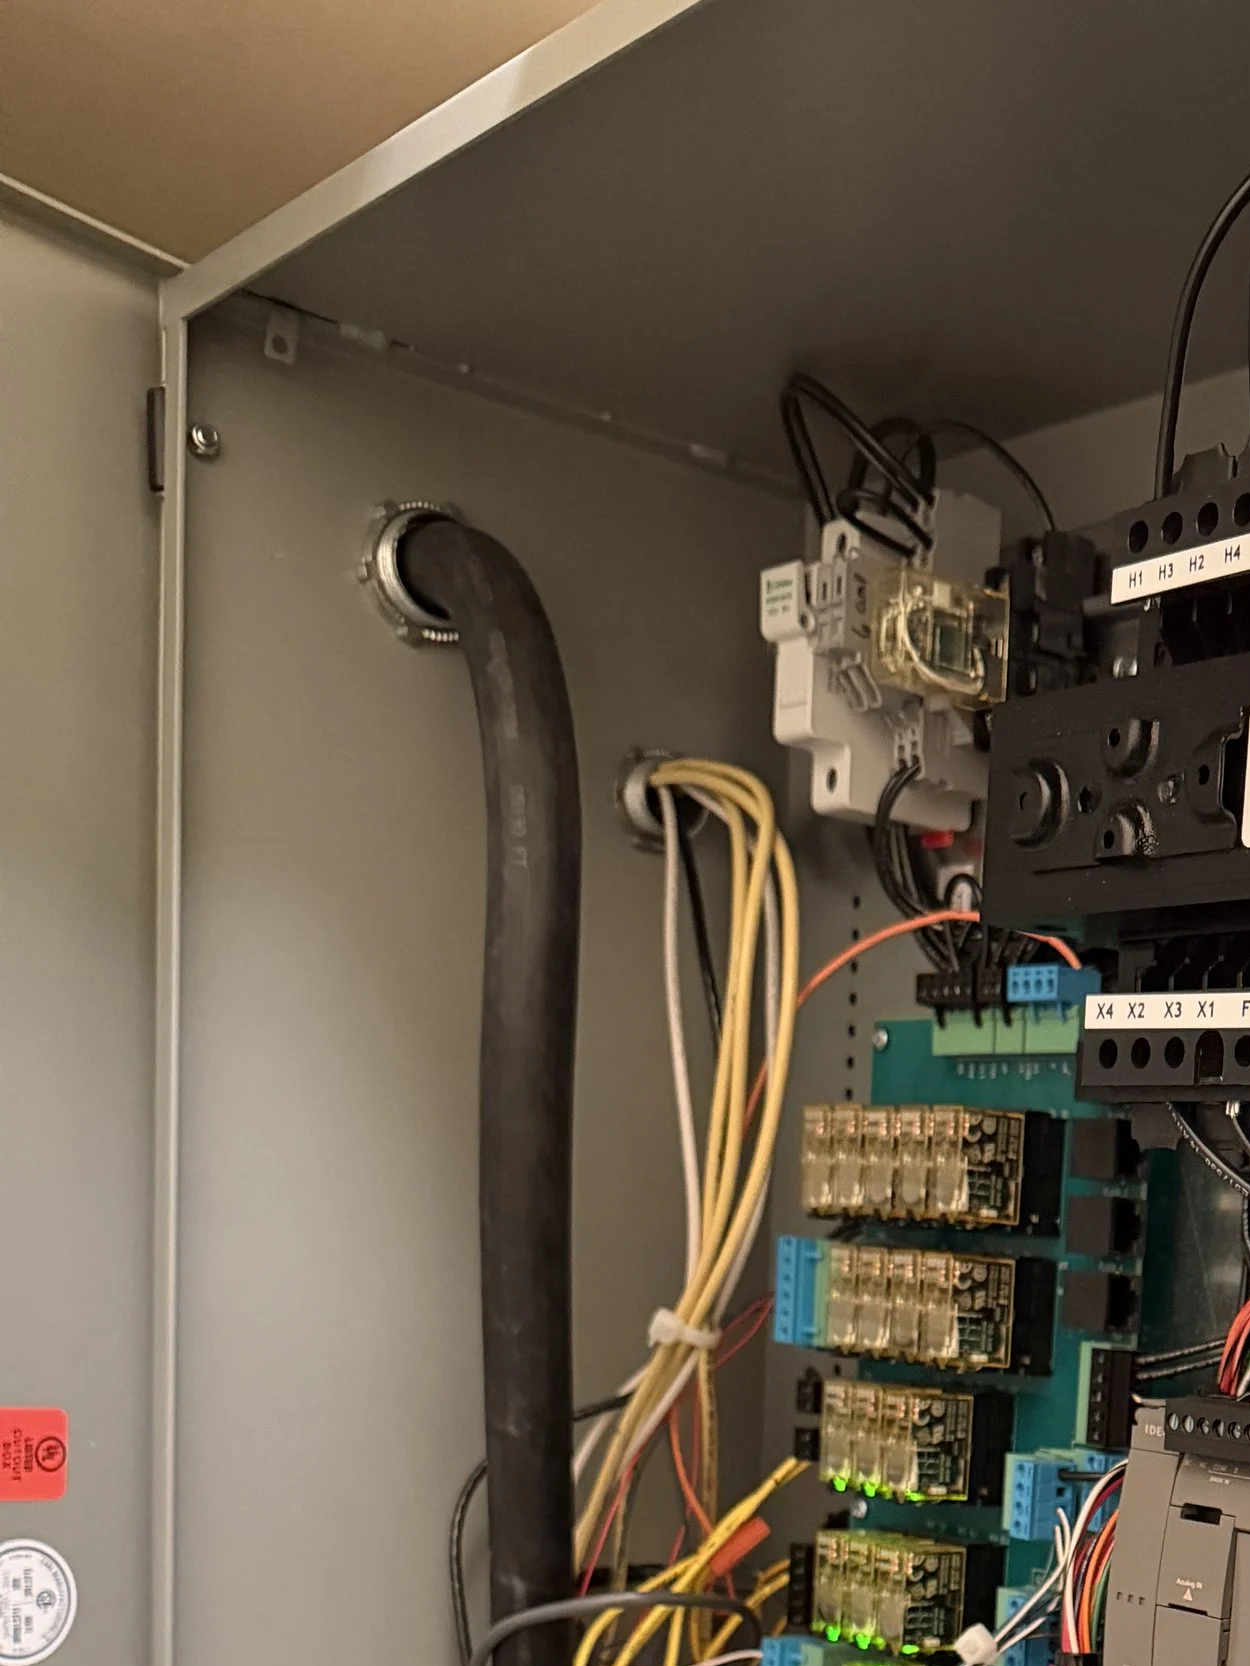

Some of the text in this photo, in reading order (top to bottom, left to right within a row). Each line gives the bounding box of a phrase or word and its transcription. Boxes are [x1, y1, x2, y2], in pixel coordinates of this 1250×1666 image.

[1129, 546, 1241, 588] H1 H3 H2 H4
[1096, 1000, 1250, 1019] X4 X2 X3 X1 F
